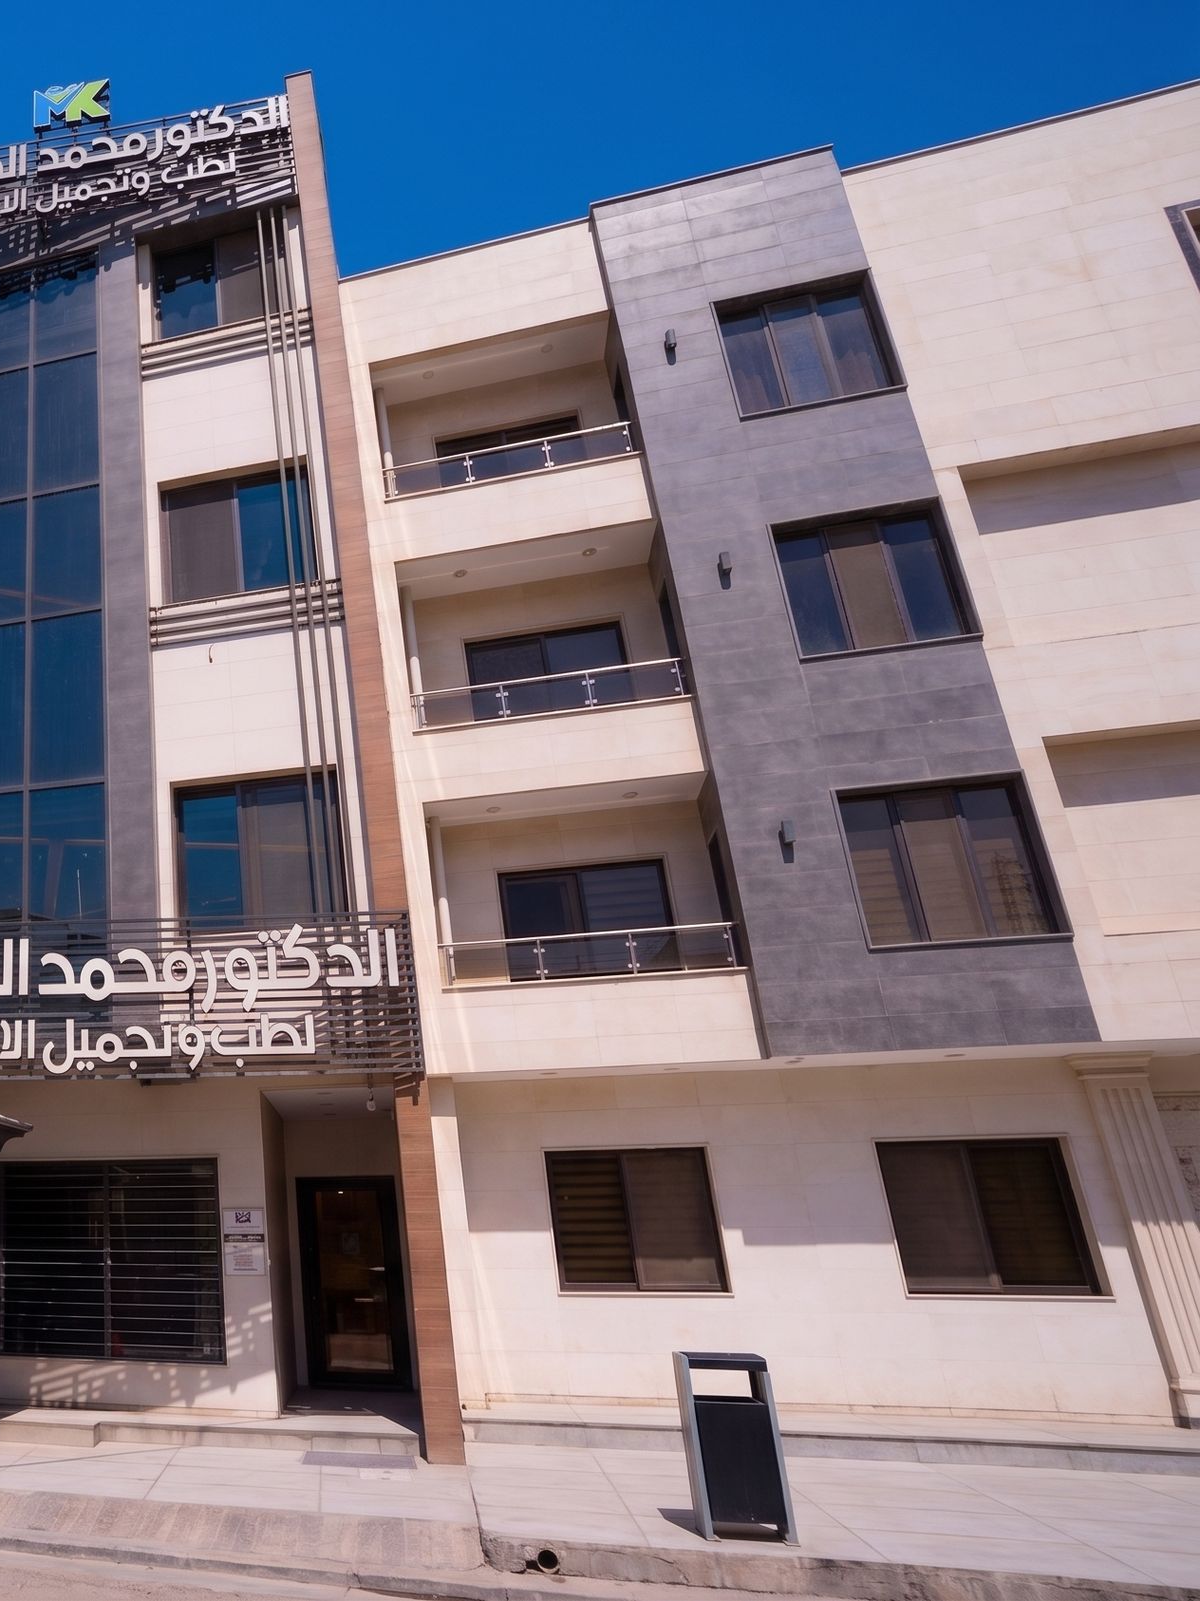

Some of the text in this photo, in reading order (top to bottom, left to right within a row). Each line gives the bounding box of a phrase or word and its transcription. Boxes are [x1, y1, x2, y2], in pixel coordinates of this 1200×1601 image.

[37, 132, 148, 173] محمد
[145, 95, 289, 162] الدكتور
[35, 167, 150, 213] وتجميل
[161, 152, 237, 190] لطب
[38, 946, 199, 1002] محمد
[200, 923, 400, 1014] الدكتور
[42, 1014, 205, 1073] وتجميل
[208, 1013, 316, 1069] لطب
